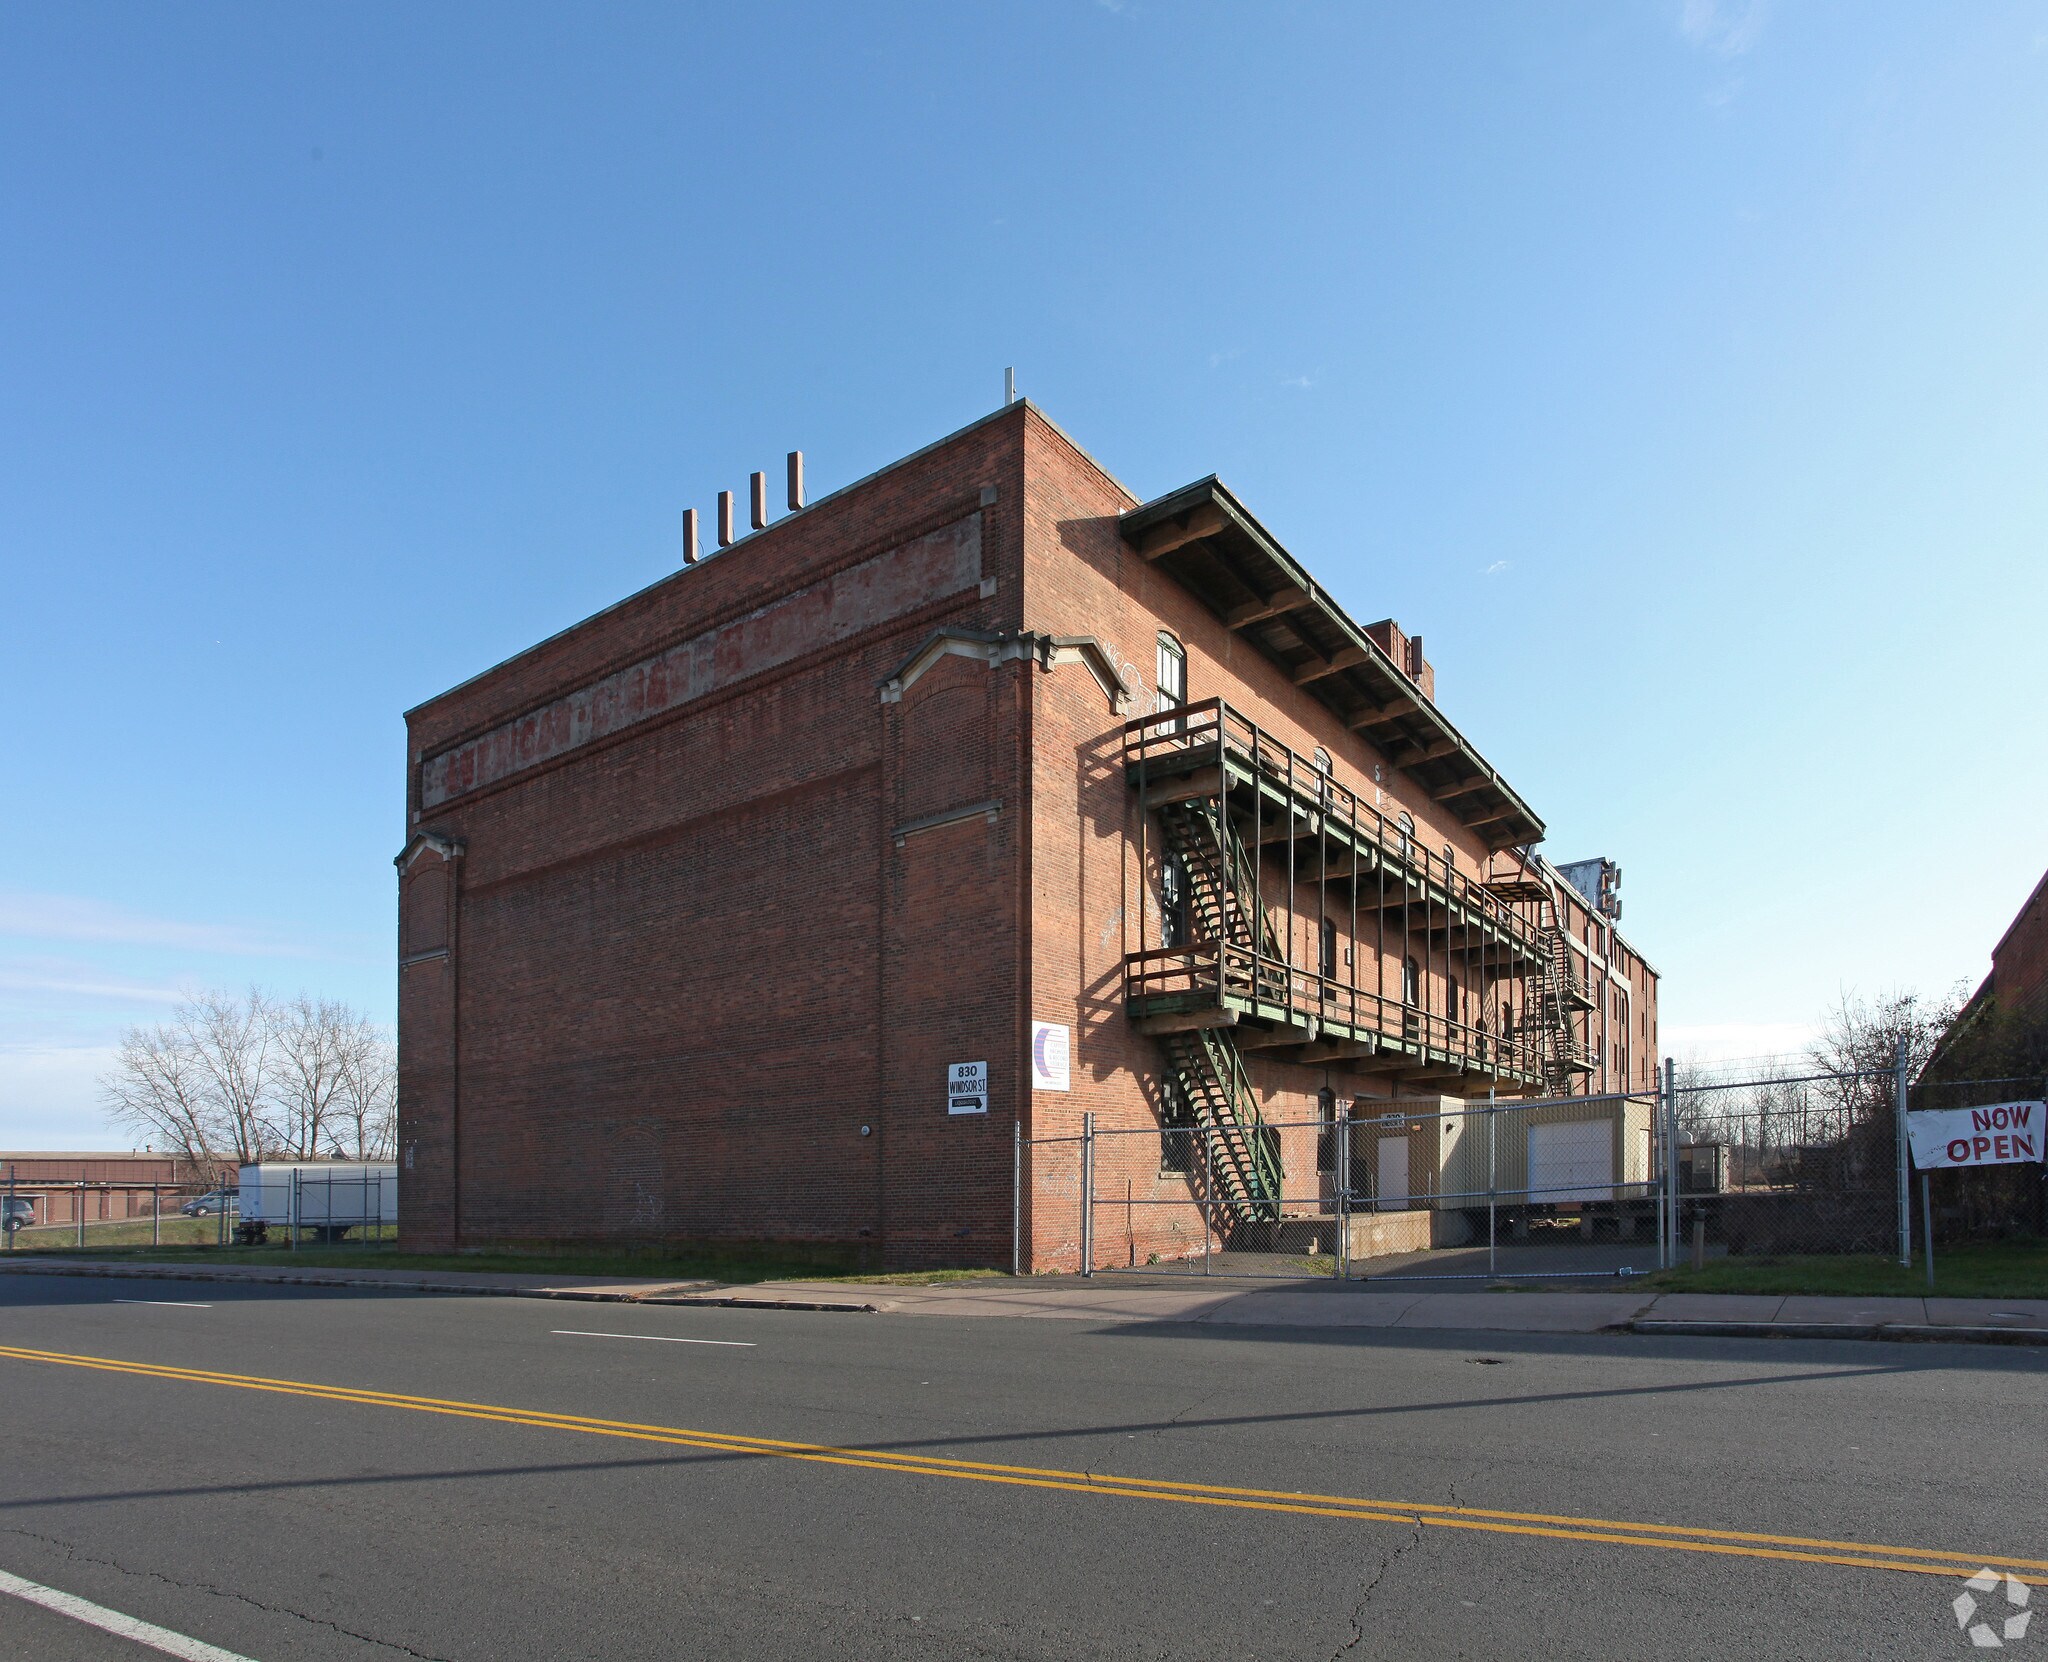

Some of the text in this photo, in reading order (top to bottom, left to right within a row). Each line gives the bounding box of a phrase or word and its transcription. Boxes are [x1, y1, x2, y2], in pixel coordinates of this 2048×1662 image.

[958, 1066, 977, 1077] 830
[950, 1079, 986, 1094] WINDSOR ST
[1971, 1106, 2031, 1131] NOW
[1947, 1135, 2035, 1162] OPEN
